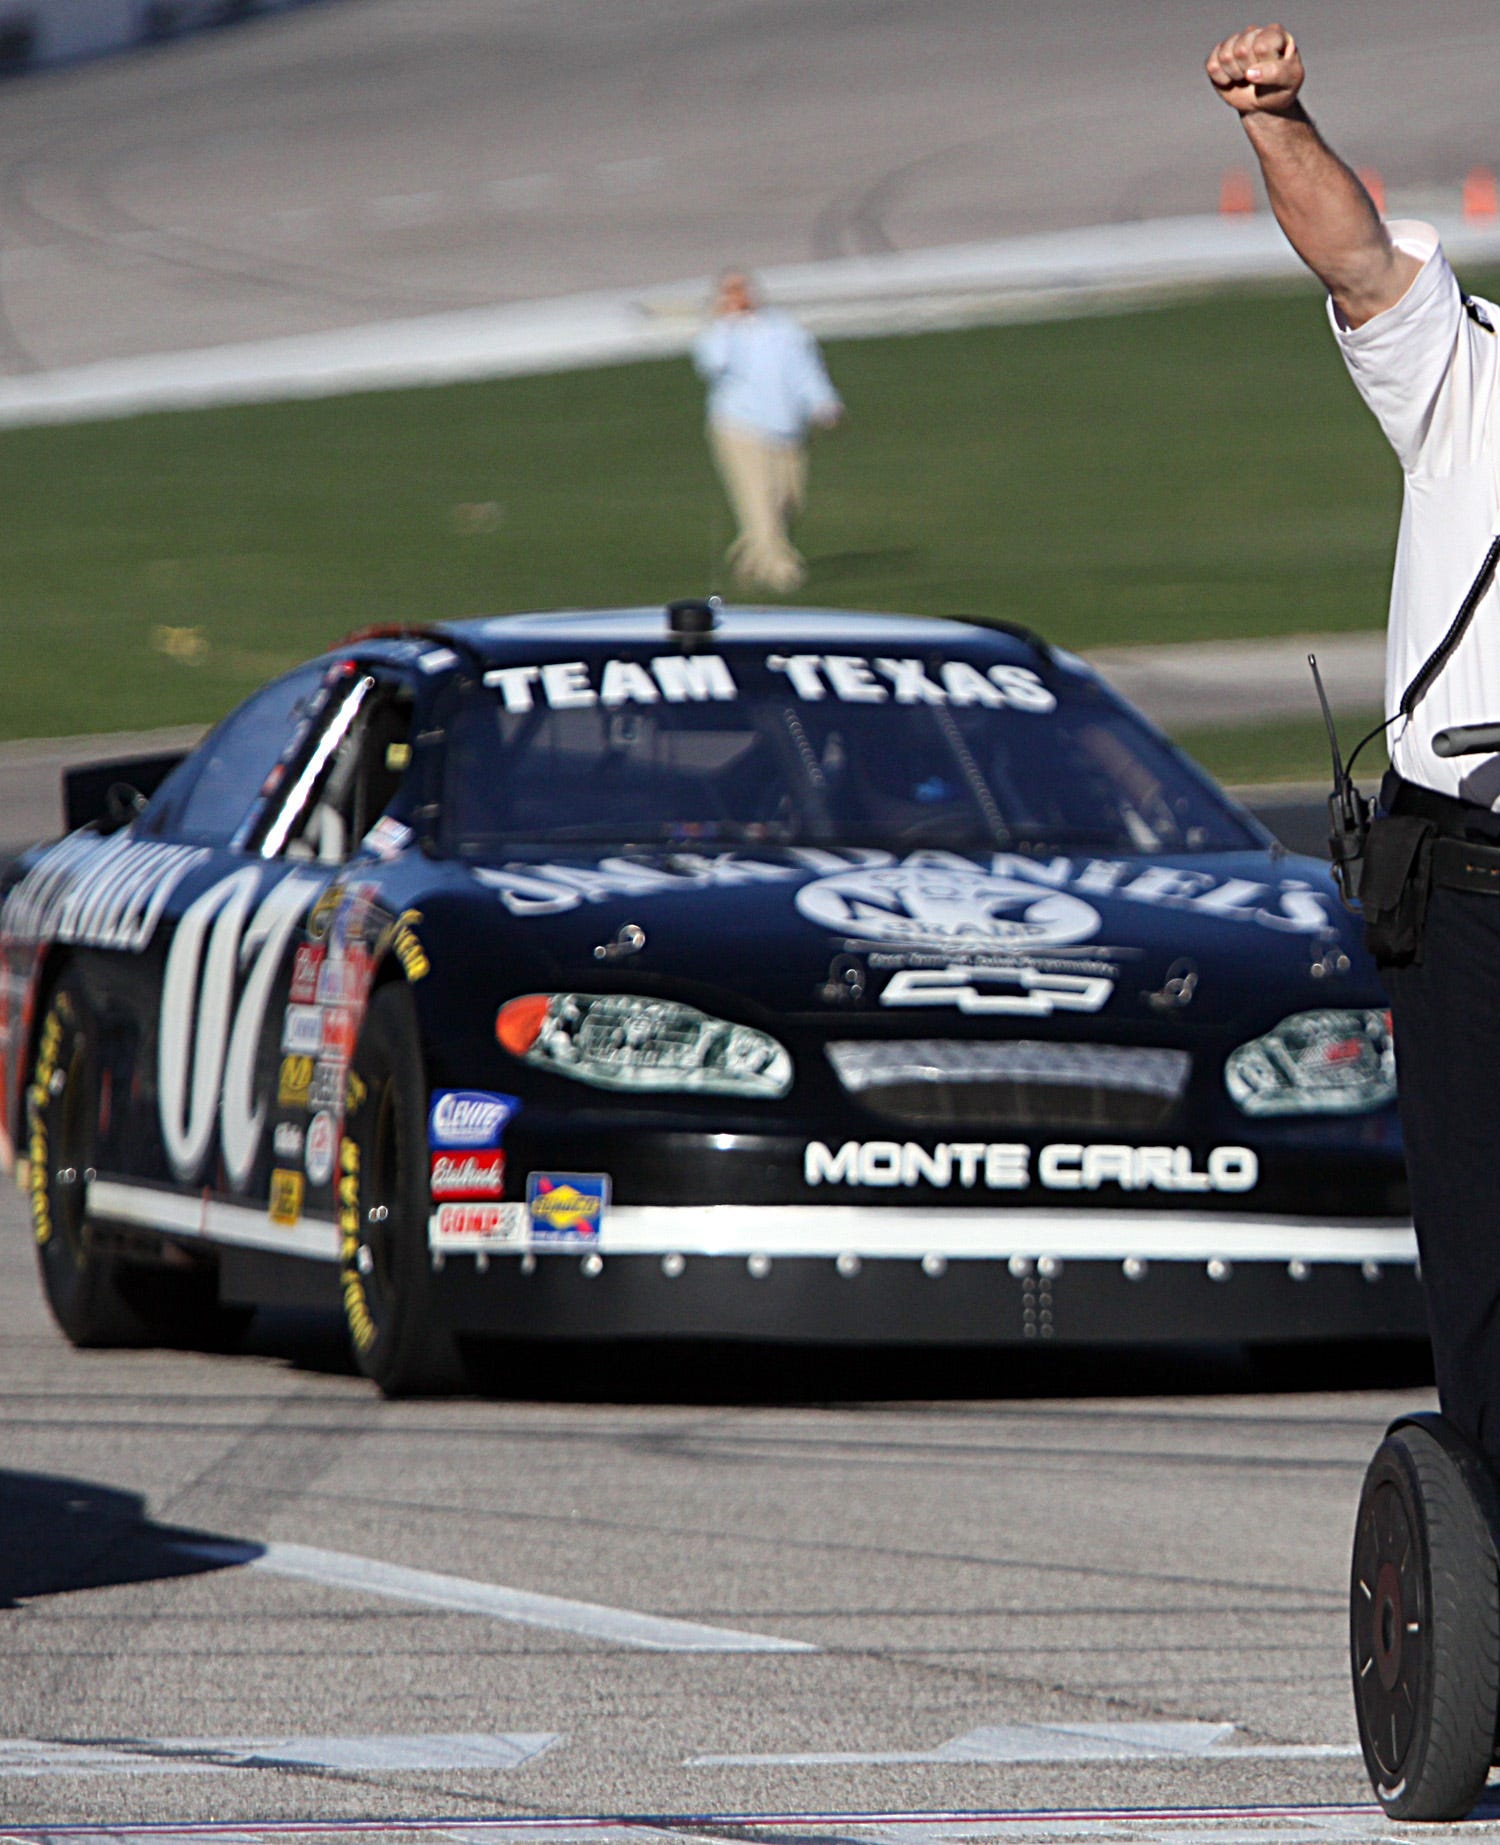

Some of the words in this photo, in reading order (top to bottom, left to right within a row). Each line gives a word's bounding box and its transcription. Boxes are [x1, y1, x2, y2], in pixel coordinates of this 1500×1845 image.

[484, 655, 738, 714] TEAM
[767, 654, 1057, 714] TEXAS
[804, 1141, 1030, 1189] MONTE
[1039, 1143, 1260, 1193] CARLO
